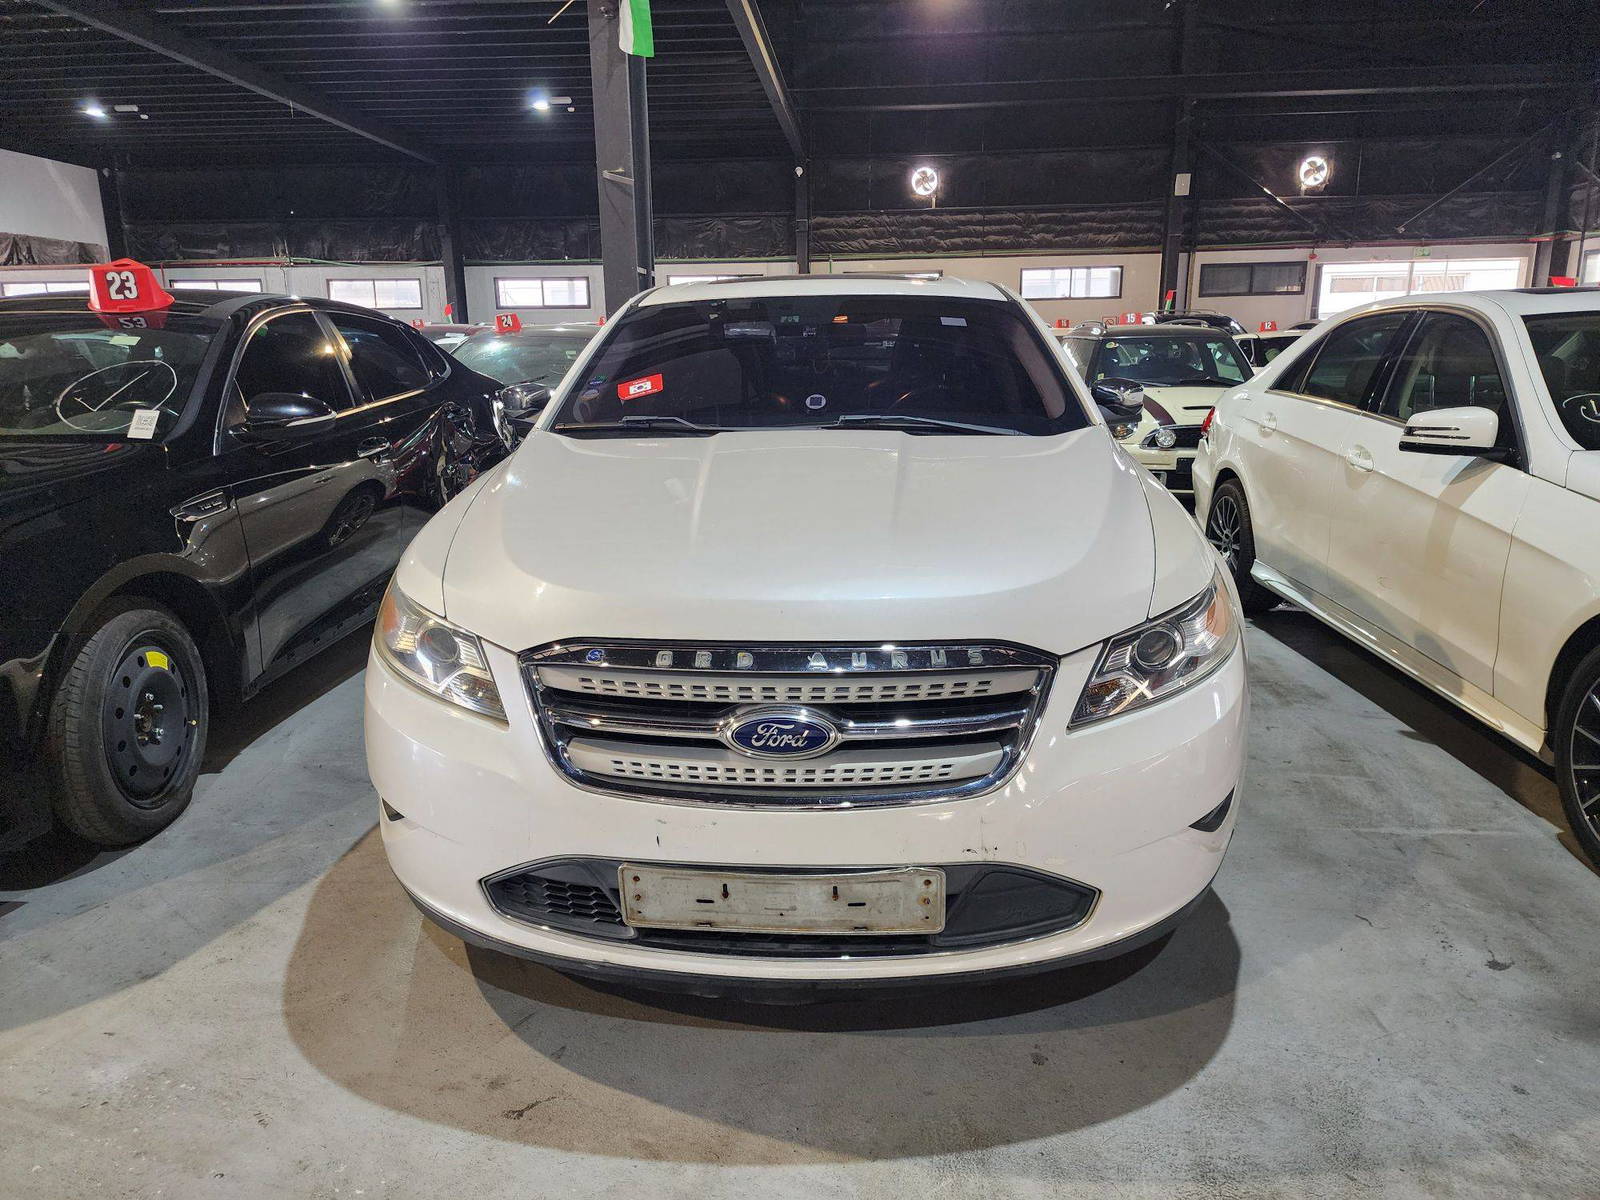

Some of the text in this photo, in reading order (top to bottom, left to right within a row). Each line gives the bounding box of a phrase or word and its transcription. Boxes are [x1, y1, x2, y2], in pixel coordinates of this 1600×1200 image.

[106, 271, 137, 299] 23
[501, 315, 513, 328] 24
[1127, 313, 1136, 323] 15
[1265, 321, 1272, 330] 12
[751, 722, 809, 747] Ford
